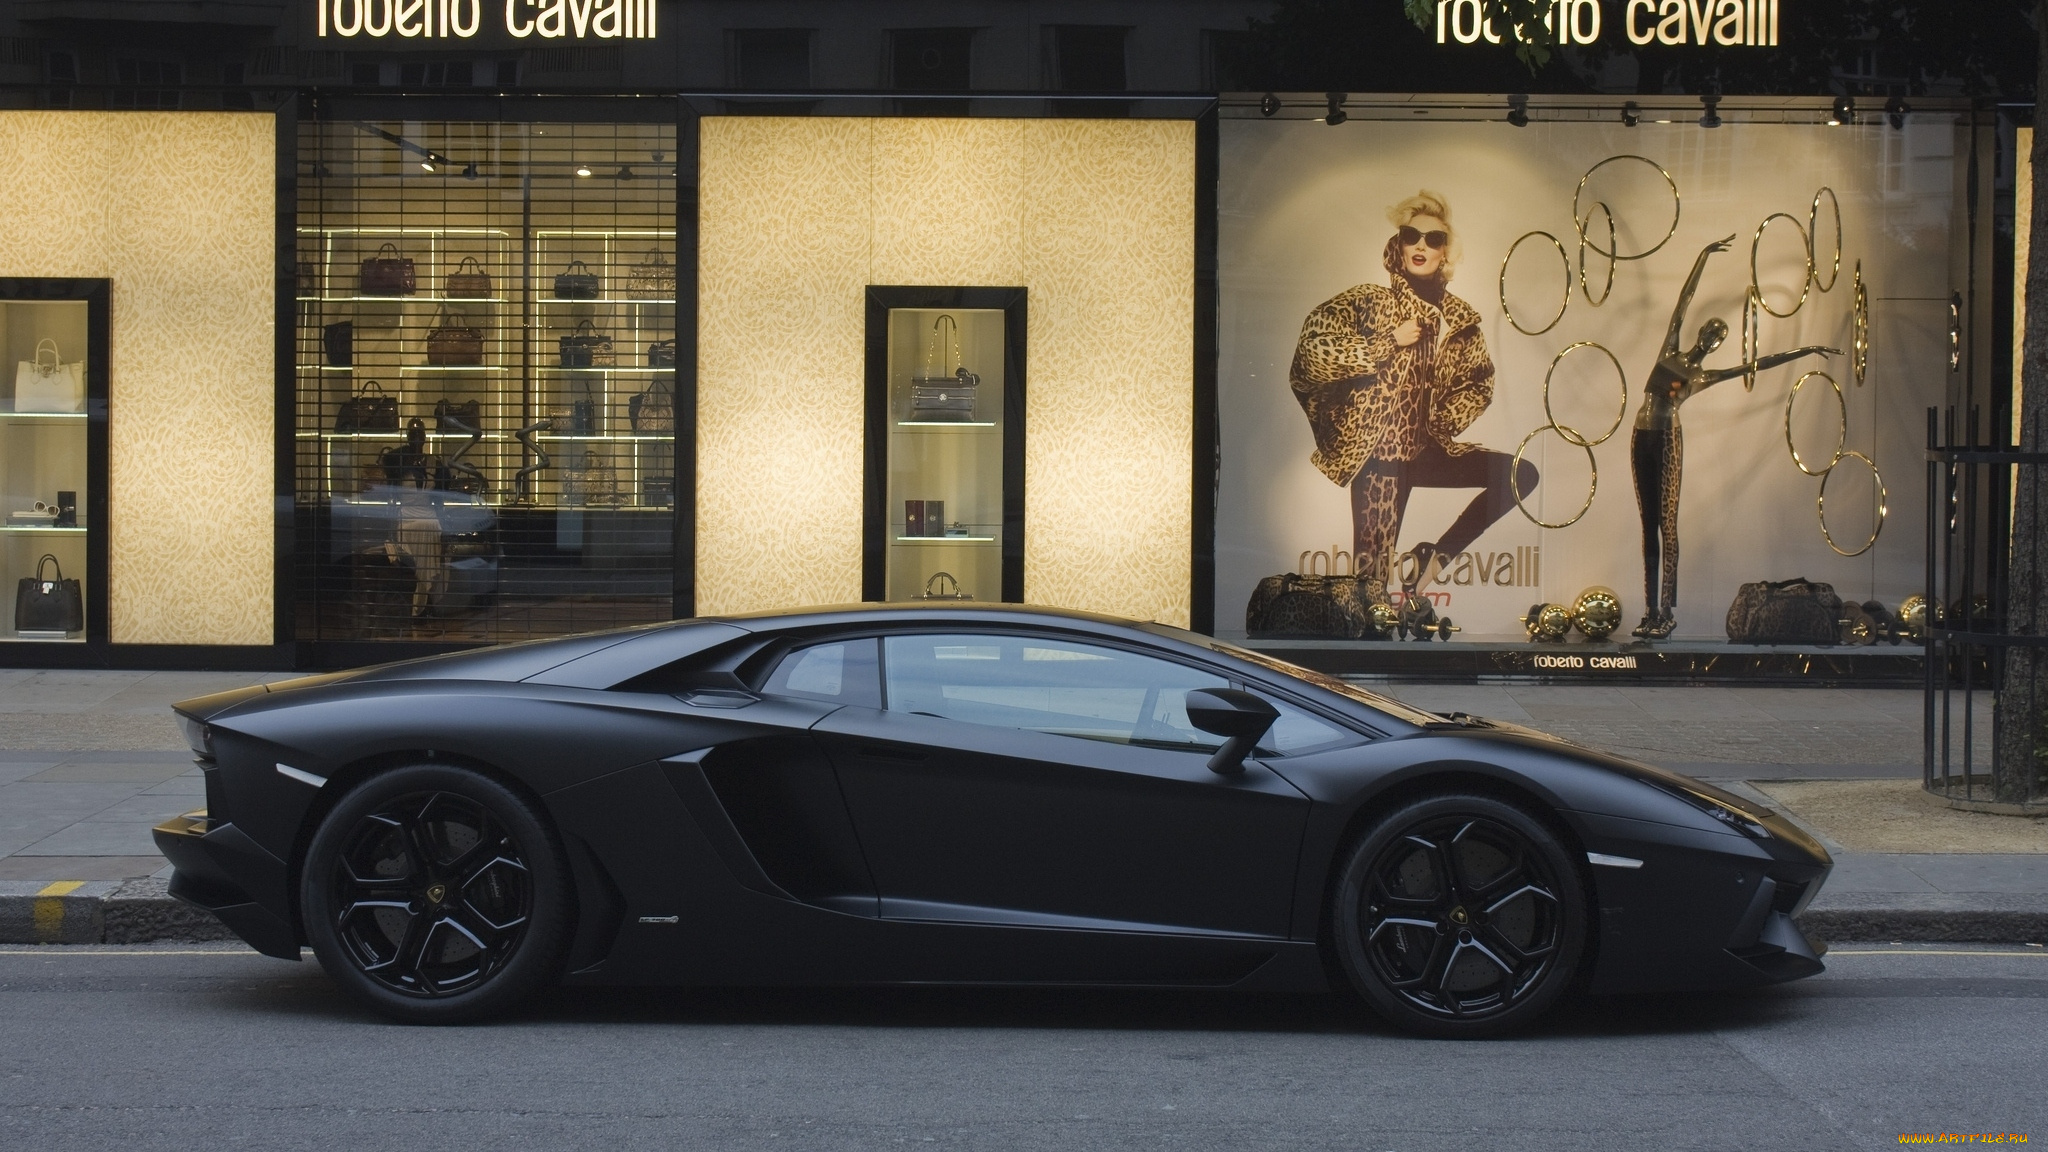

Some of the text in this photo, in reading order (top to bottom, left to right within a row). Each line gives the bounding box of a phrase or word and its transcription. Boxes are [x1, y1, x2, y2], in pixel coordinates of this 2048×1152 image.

[1626, 0, 1778, 46] cavalli
[1432, 545, 1540, 587] cavalli
[1389, 591, 1452, 611] gm
[1533, 654, 1638, 669] roberto cavalli
